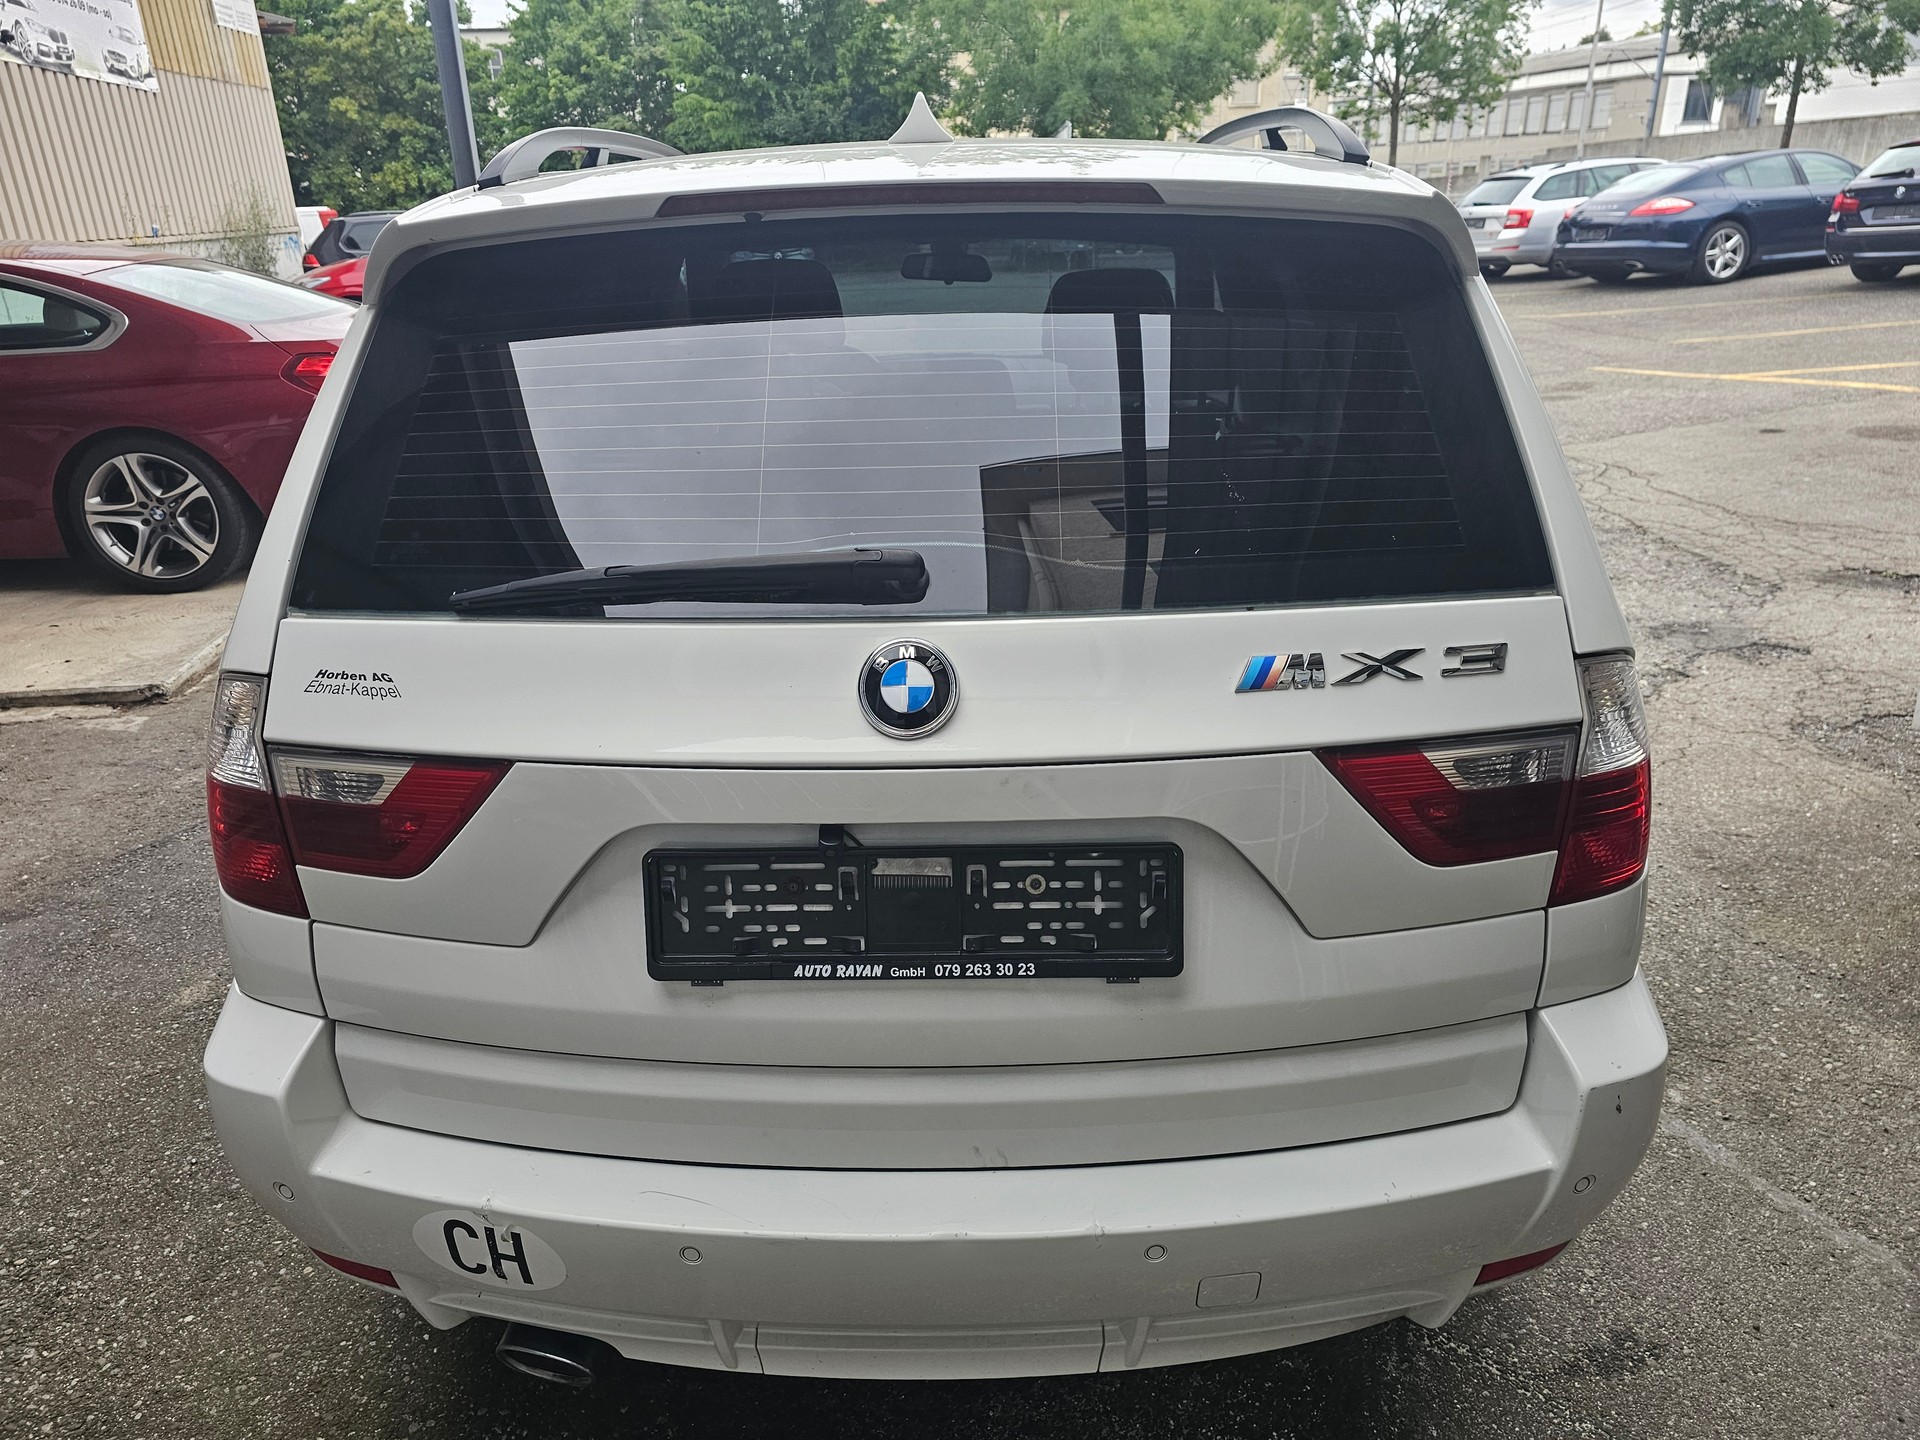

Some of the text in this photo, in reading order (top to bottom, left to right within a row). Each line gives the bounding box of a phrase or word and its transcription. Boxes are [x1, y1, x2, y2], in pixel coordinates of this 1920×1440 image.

[873, 645, 944, 673] BMW
[315, 669, 394, 683] Horben AG
[304, 680, 402, 700] Ebnat-Kappel
[794, 963, 1036, 978] AUTO RAYAN GmbH 079 263 30 23
[443, 1219, 534, 1285] CH
